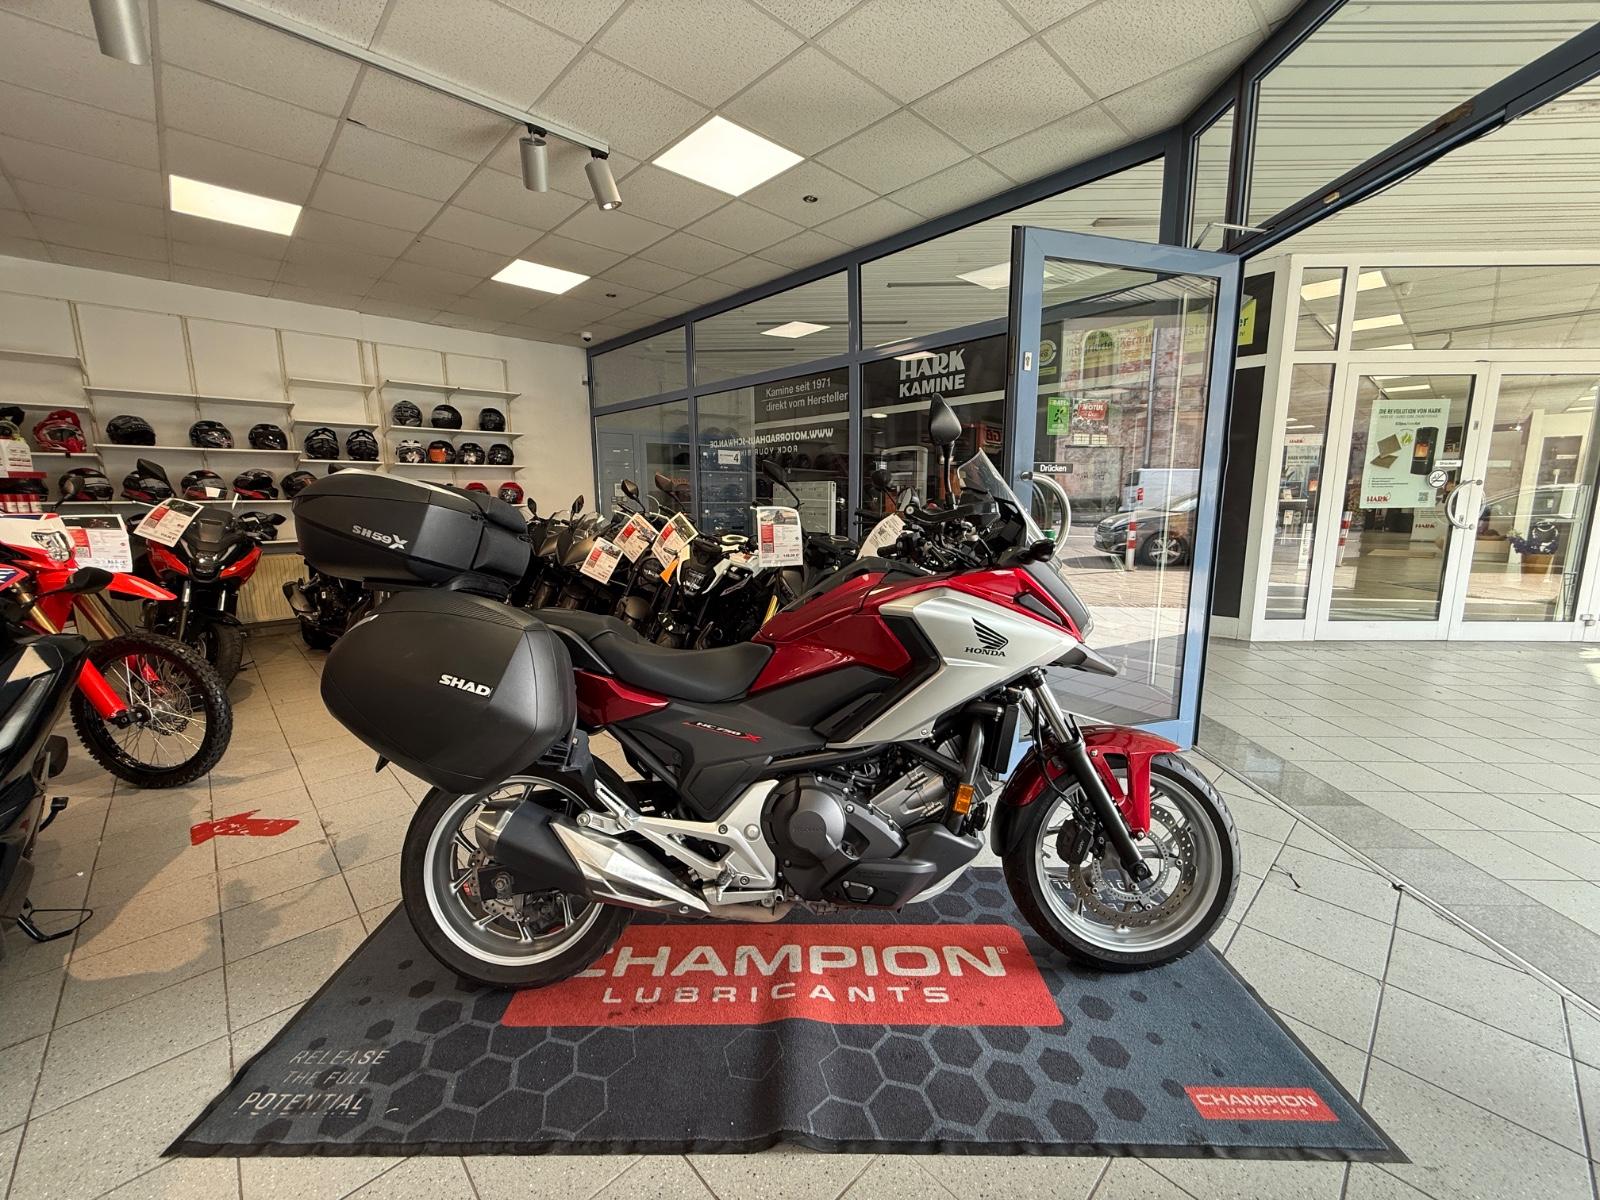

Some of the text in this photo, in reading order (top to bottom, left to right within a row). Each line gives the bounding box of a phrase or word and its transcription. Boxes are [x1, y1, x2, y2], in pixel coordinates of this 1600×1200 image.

[900, 349, 965, 380] HARK
[766, 377, 831, 397] Kamine seit 1971
[899, 374, 965, 398] KAMINE
[766, 391, 849, 412] direkt vom Hersteller
[733, 454, 739, 463] 4
[1040, 463, 1067, 472] Drücken
[352, 525, 408, 550] SH59X
[965, 647, 1006, 657] HONDA
[439, 674, 491, 697] SHAD
[602, 982, 950, 1003] LUBRICANTS
[289, 1050, 390, 1065] RELEASE
[283, 1071, 370, 1085] THE FULL
[238, 1092, 366, 1111] POTENTIAL
[1195, 1094, 1318, 1107] CHAMPION
[1220, 1107, 1308, 1115] LUBRICANTS
